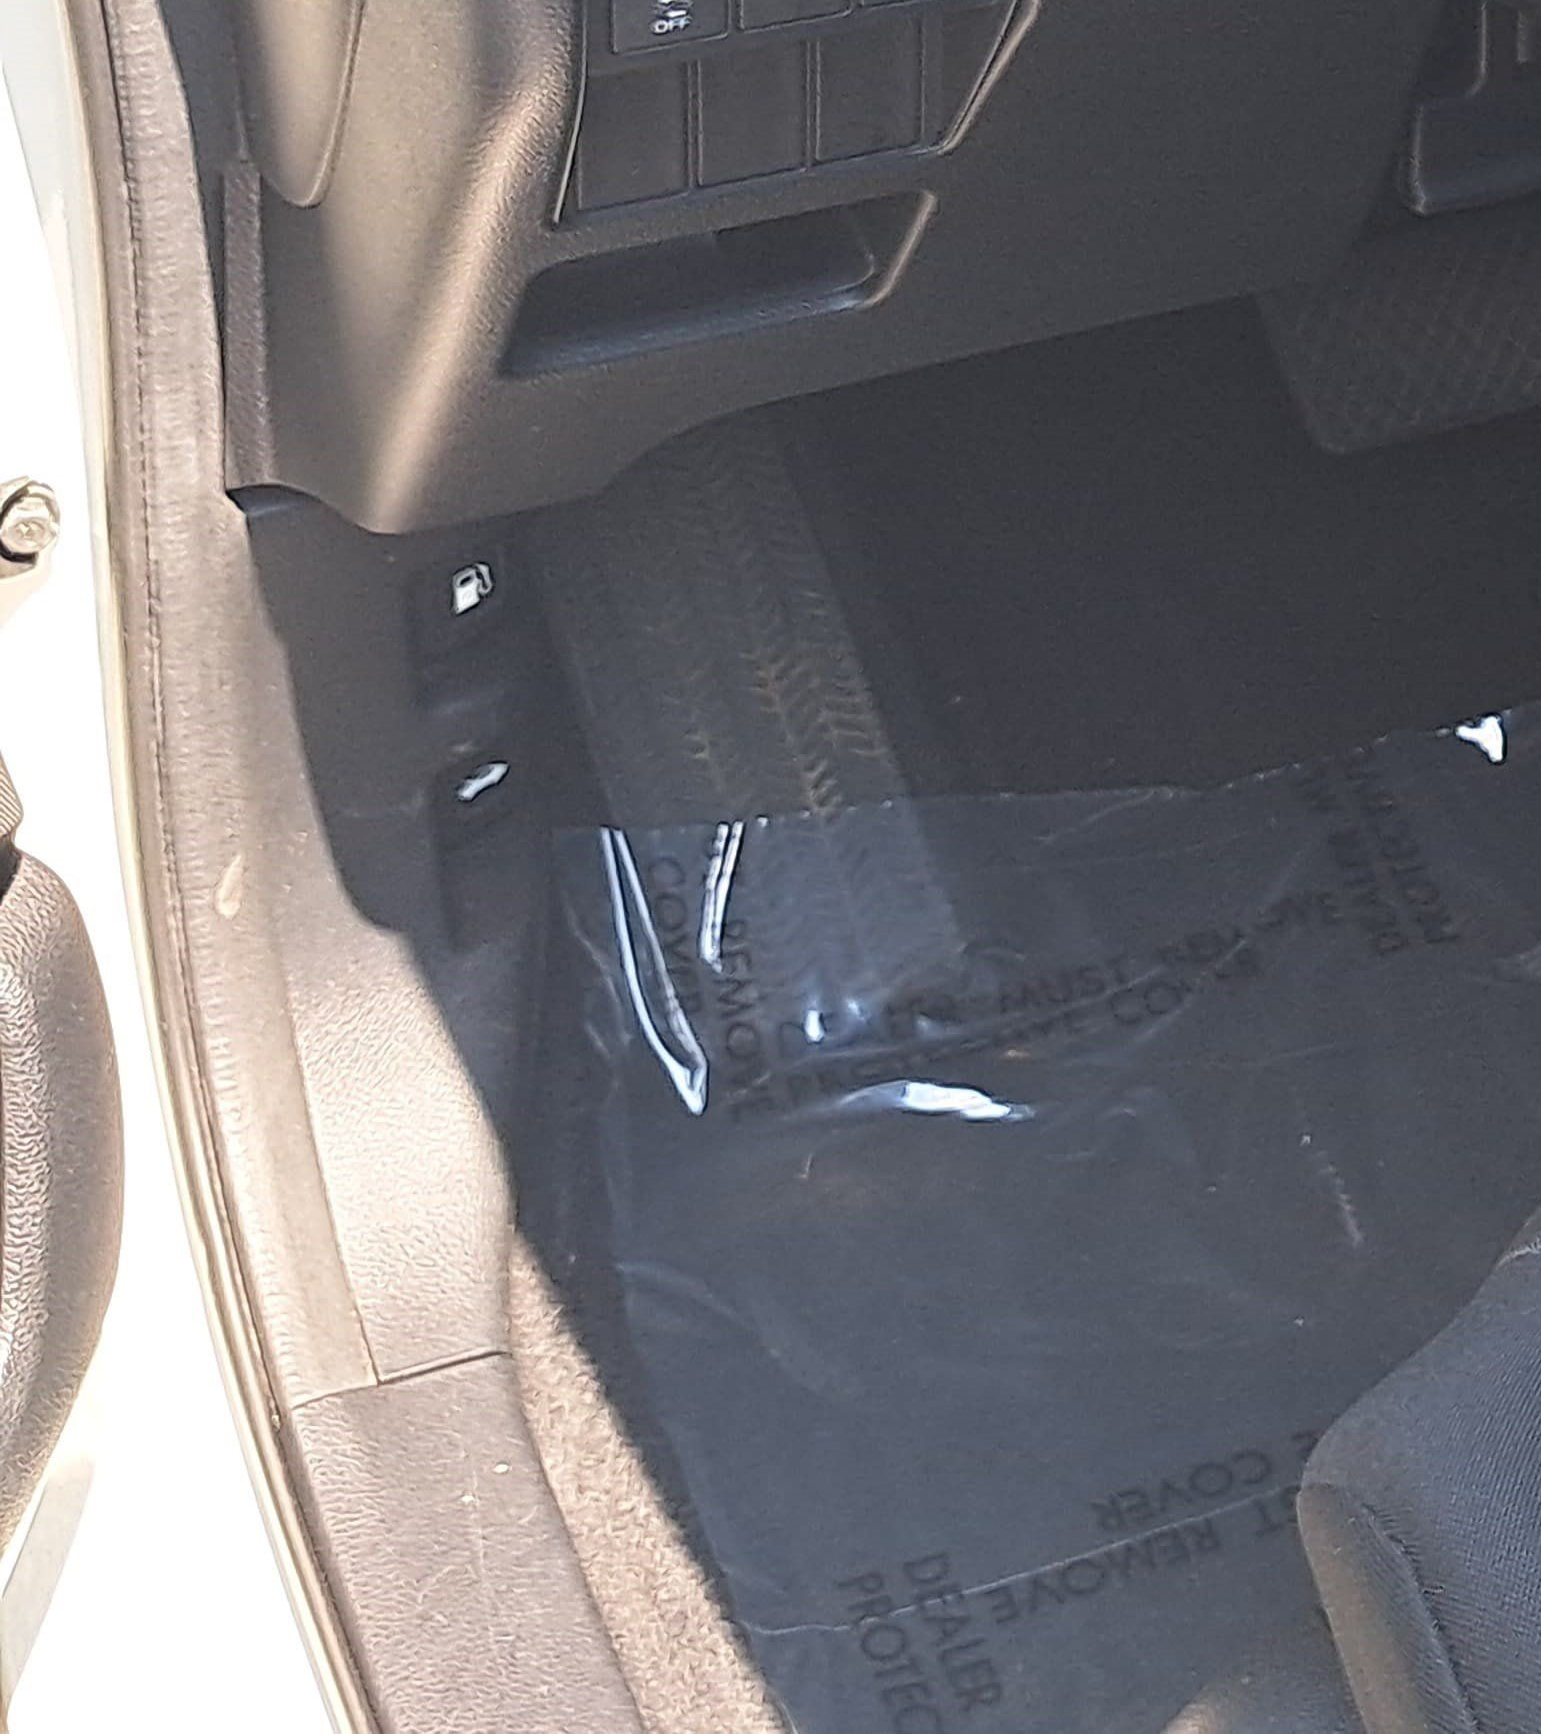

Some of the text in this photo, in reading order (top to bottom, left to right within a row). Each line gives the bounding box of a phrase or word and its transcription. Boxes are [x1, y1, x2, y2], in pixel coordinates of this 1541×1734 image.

[652, 15, 694, 35] OFF
[1089, 1448, 1274, 1531] COVER
[981, 1521, 1224, 1625] REMOVE
[902, 1551, 1003, 1713] DEALER
